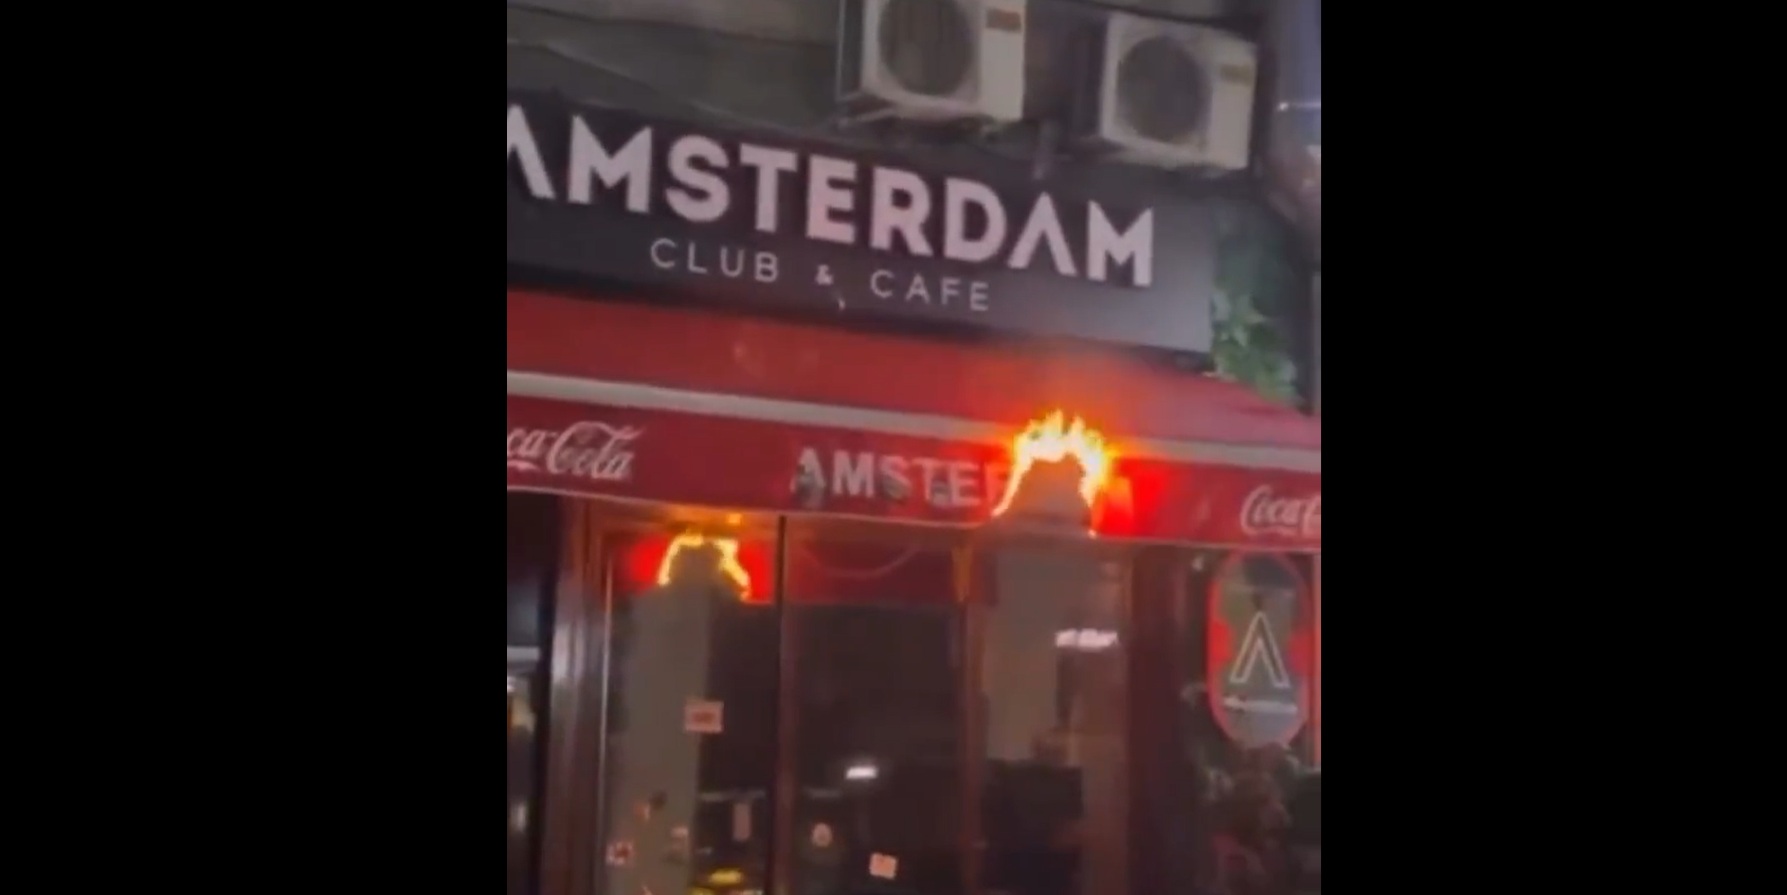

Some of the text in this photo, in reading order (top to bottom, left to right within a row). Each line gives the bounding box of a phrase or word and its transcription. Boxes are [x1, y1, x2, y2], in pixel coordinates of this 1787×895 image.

[507, 103, 1154, 287] AMSTERDAM
[650, 237, 989, 312] CLUB & CAFE
